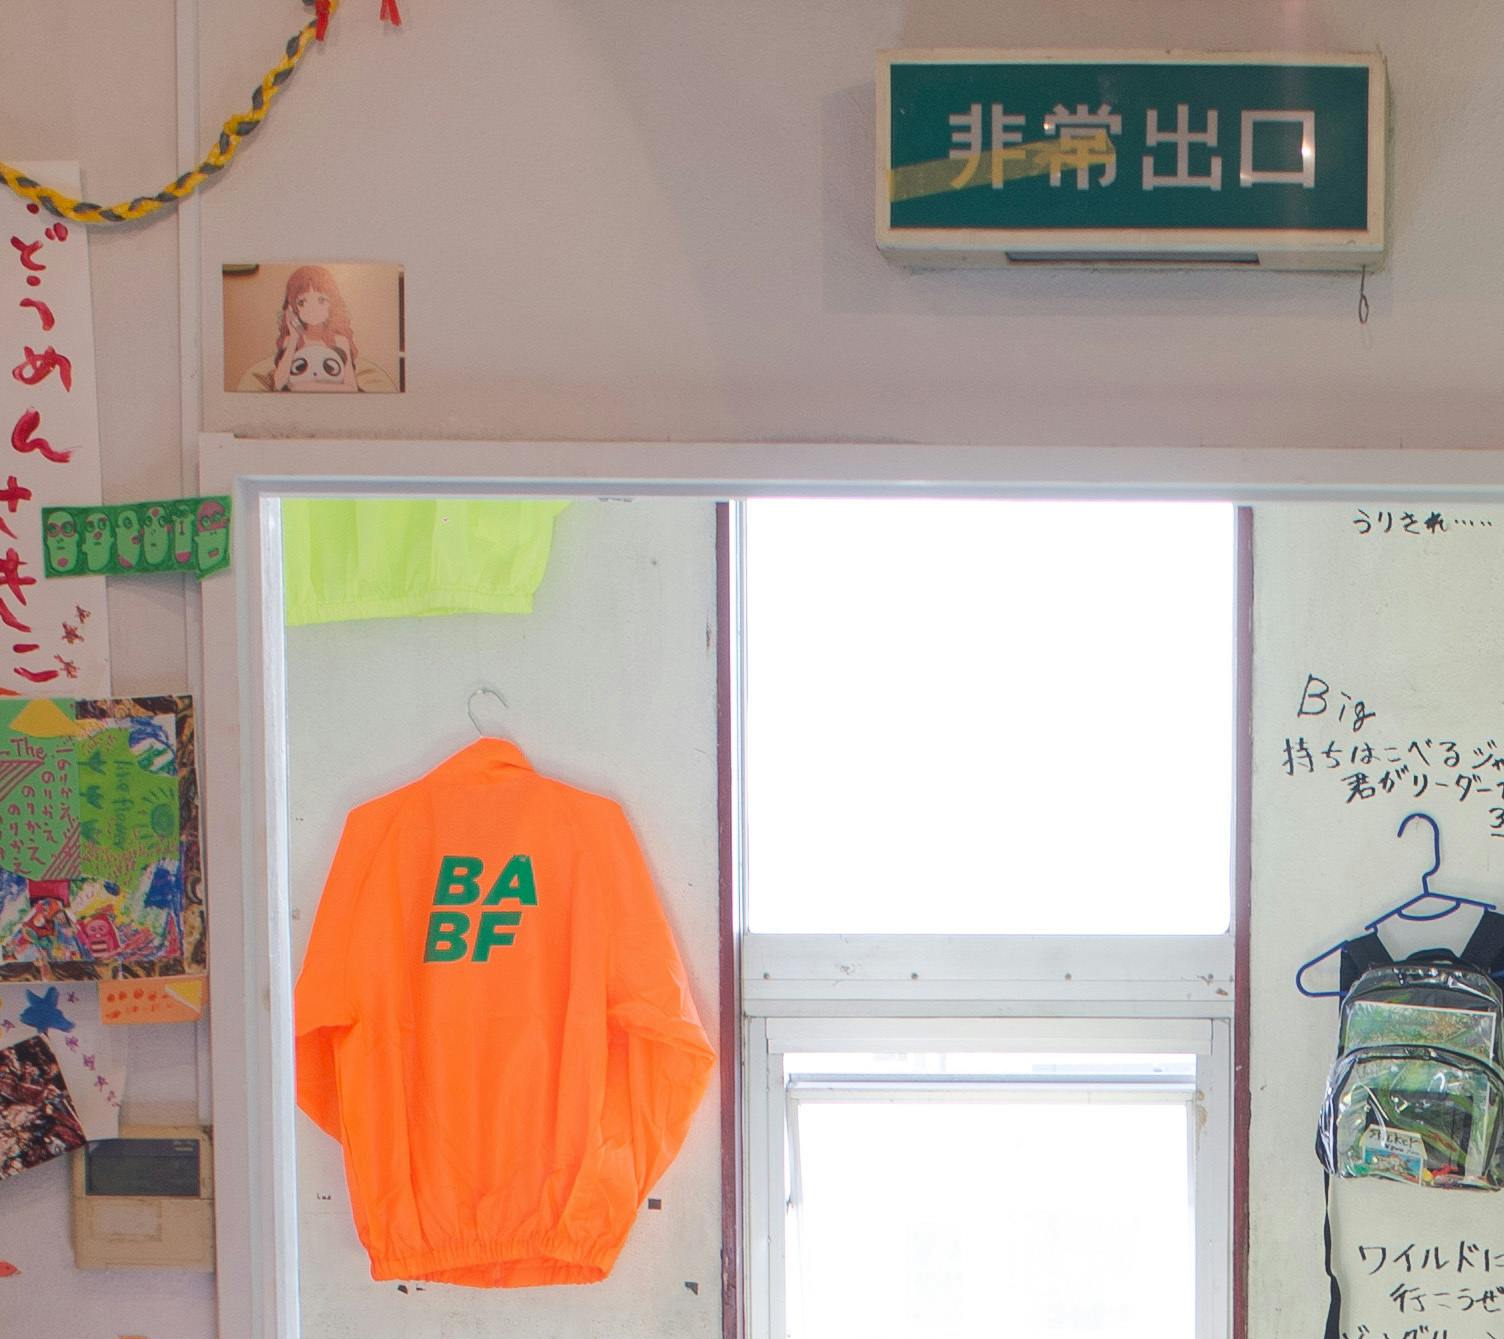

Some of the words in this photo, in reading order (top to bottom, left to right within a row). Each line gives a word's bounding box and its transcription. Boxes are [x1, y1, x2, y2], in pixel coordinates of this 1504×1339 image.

[948, 102, 1316, 190] 非常出口
[1297, 674, 1377, 732] Big
[432, 854, 538, 906] BA
[423, 911, 523, 963] BF
